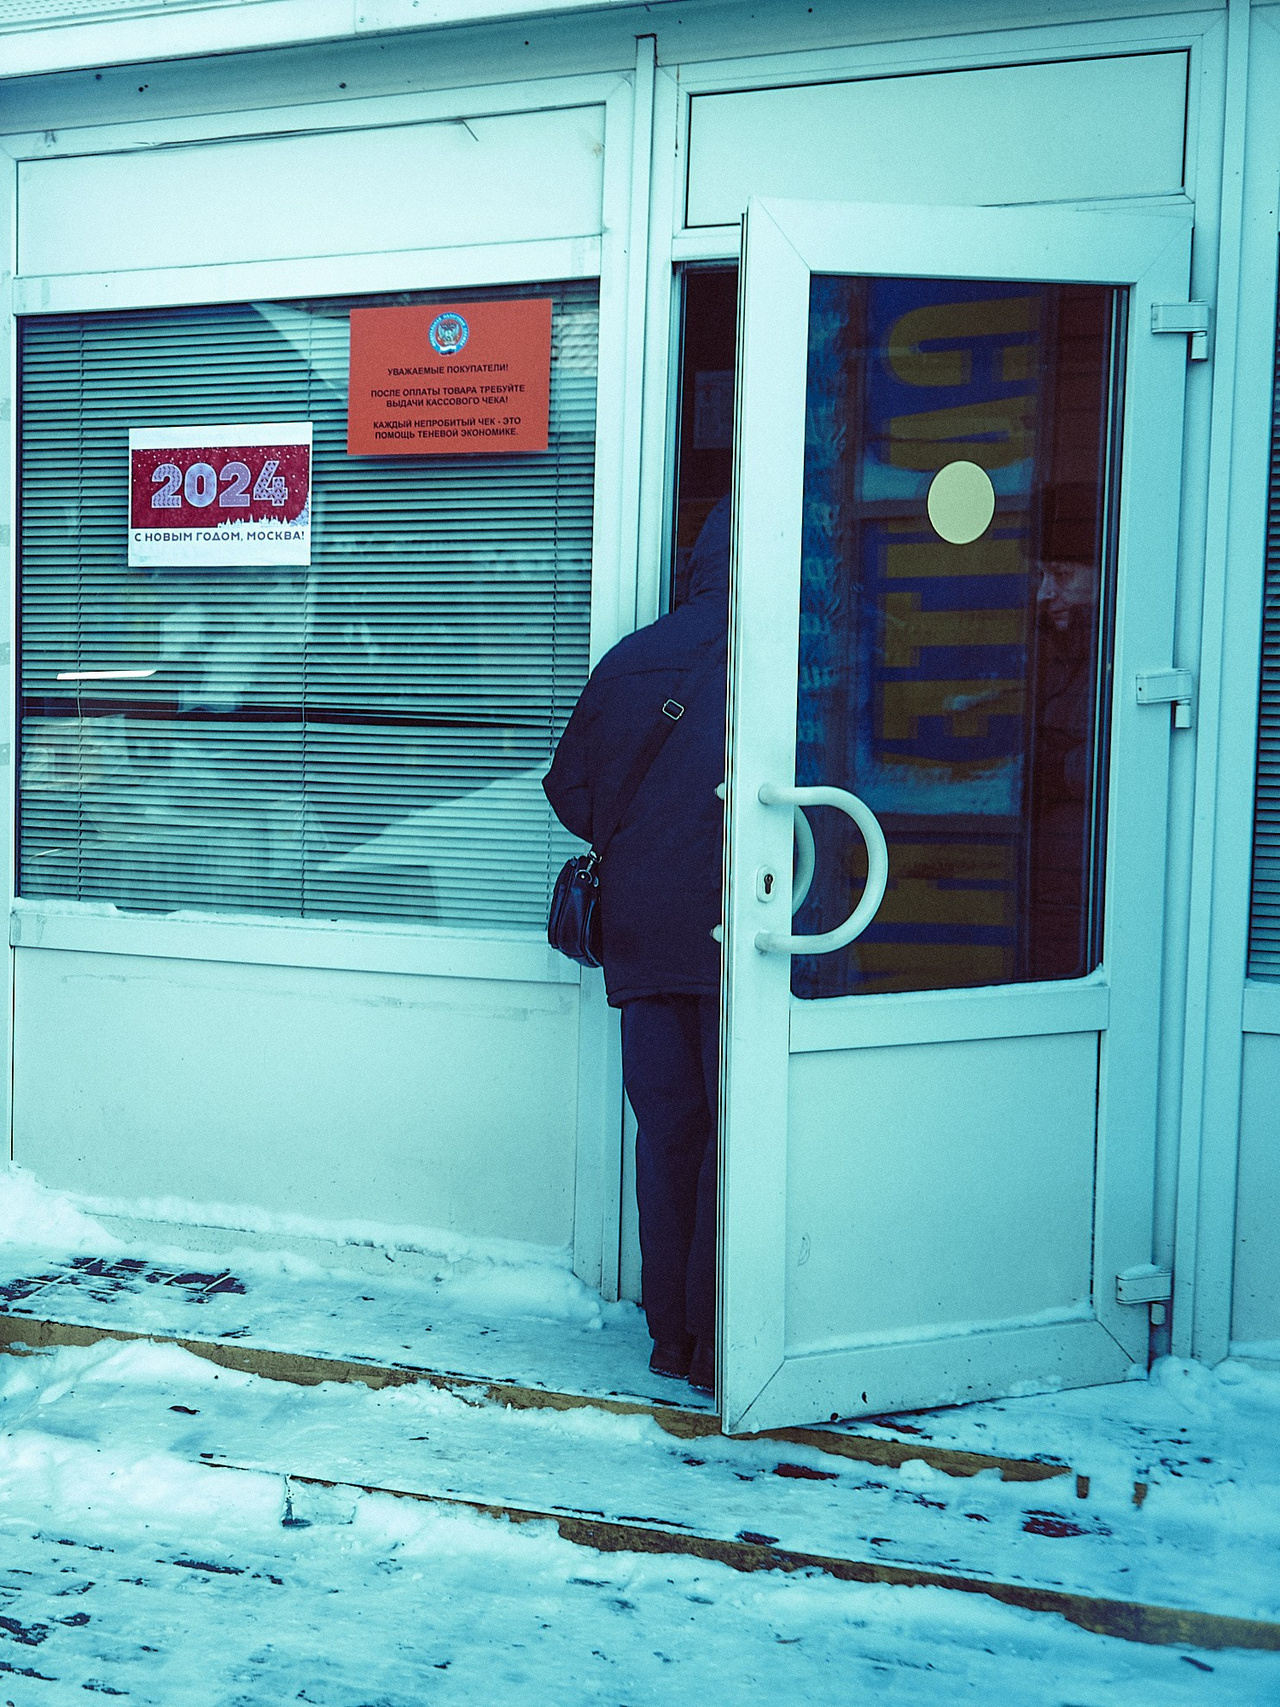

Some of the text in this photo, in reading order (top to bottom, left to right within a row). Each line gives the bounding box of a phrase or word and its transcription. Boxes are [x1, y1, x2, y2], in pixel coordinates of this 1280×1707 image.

[388, 363, 509, 376] УВАЖАЕМЫЕ ПОКУПАТЕЛИ!
[371, 384, 525, 397] ПОСЛЕ ОПЛАТЫ ТОВАРА ТРЕБУЙТЕ
[387, 395, 508, 408] ВЫДАЧИ КАССОВОГО ЧЕКА!
[373, 419, 412, 429] КАЖДЫЙ
[414, 417, 476, 428] НЕПРОБИТЫЙ
[478, 418, 495, 426] ЧЕК
[503, 417, 521, 425] ЭТО
[375, 427, 518, 439] ПОМОЩЬ ТЕНЕВОЙ ЭКОНОМИКЕ.
[151, 460, 289, 509] 2024
[134, 530, 305, 542] С НОВЫМ ГОДОМ, МОСКВА!
